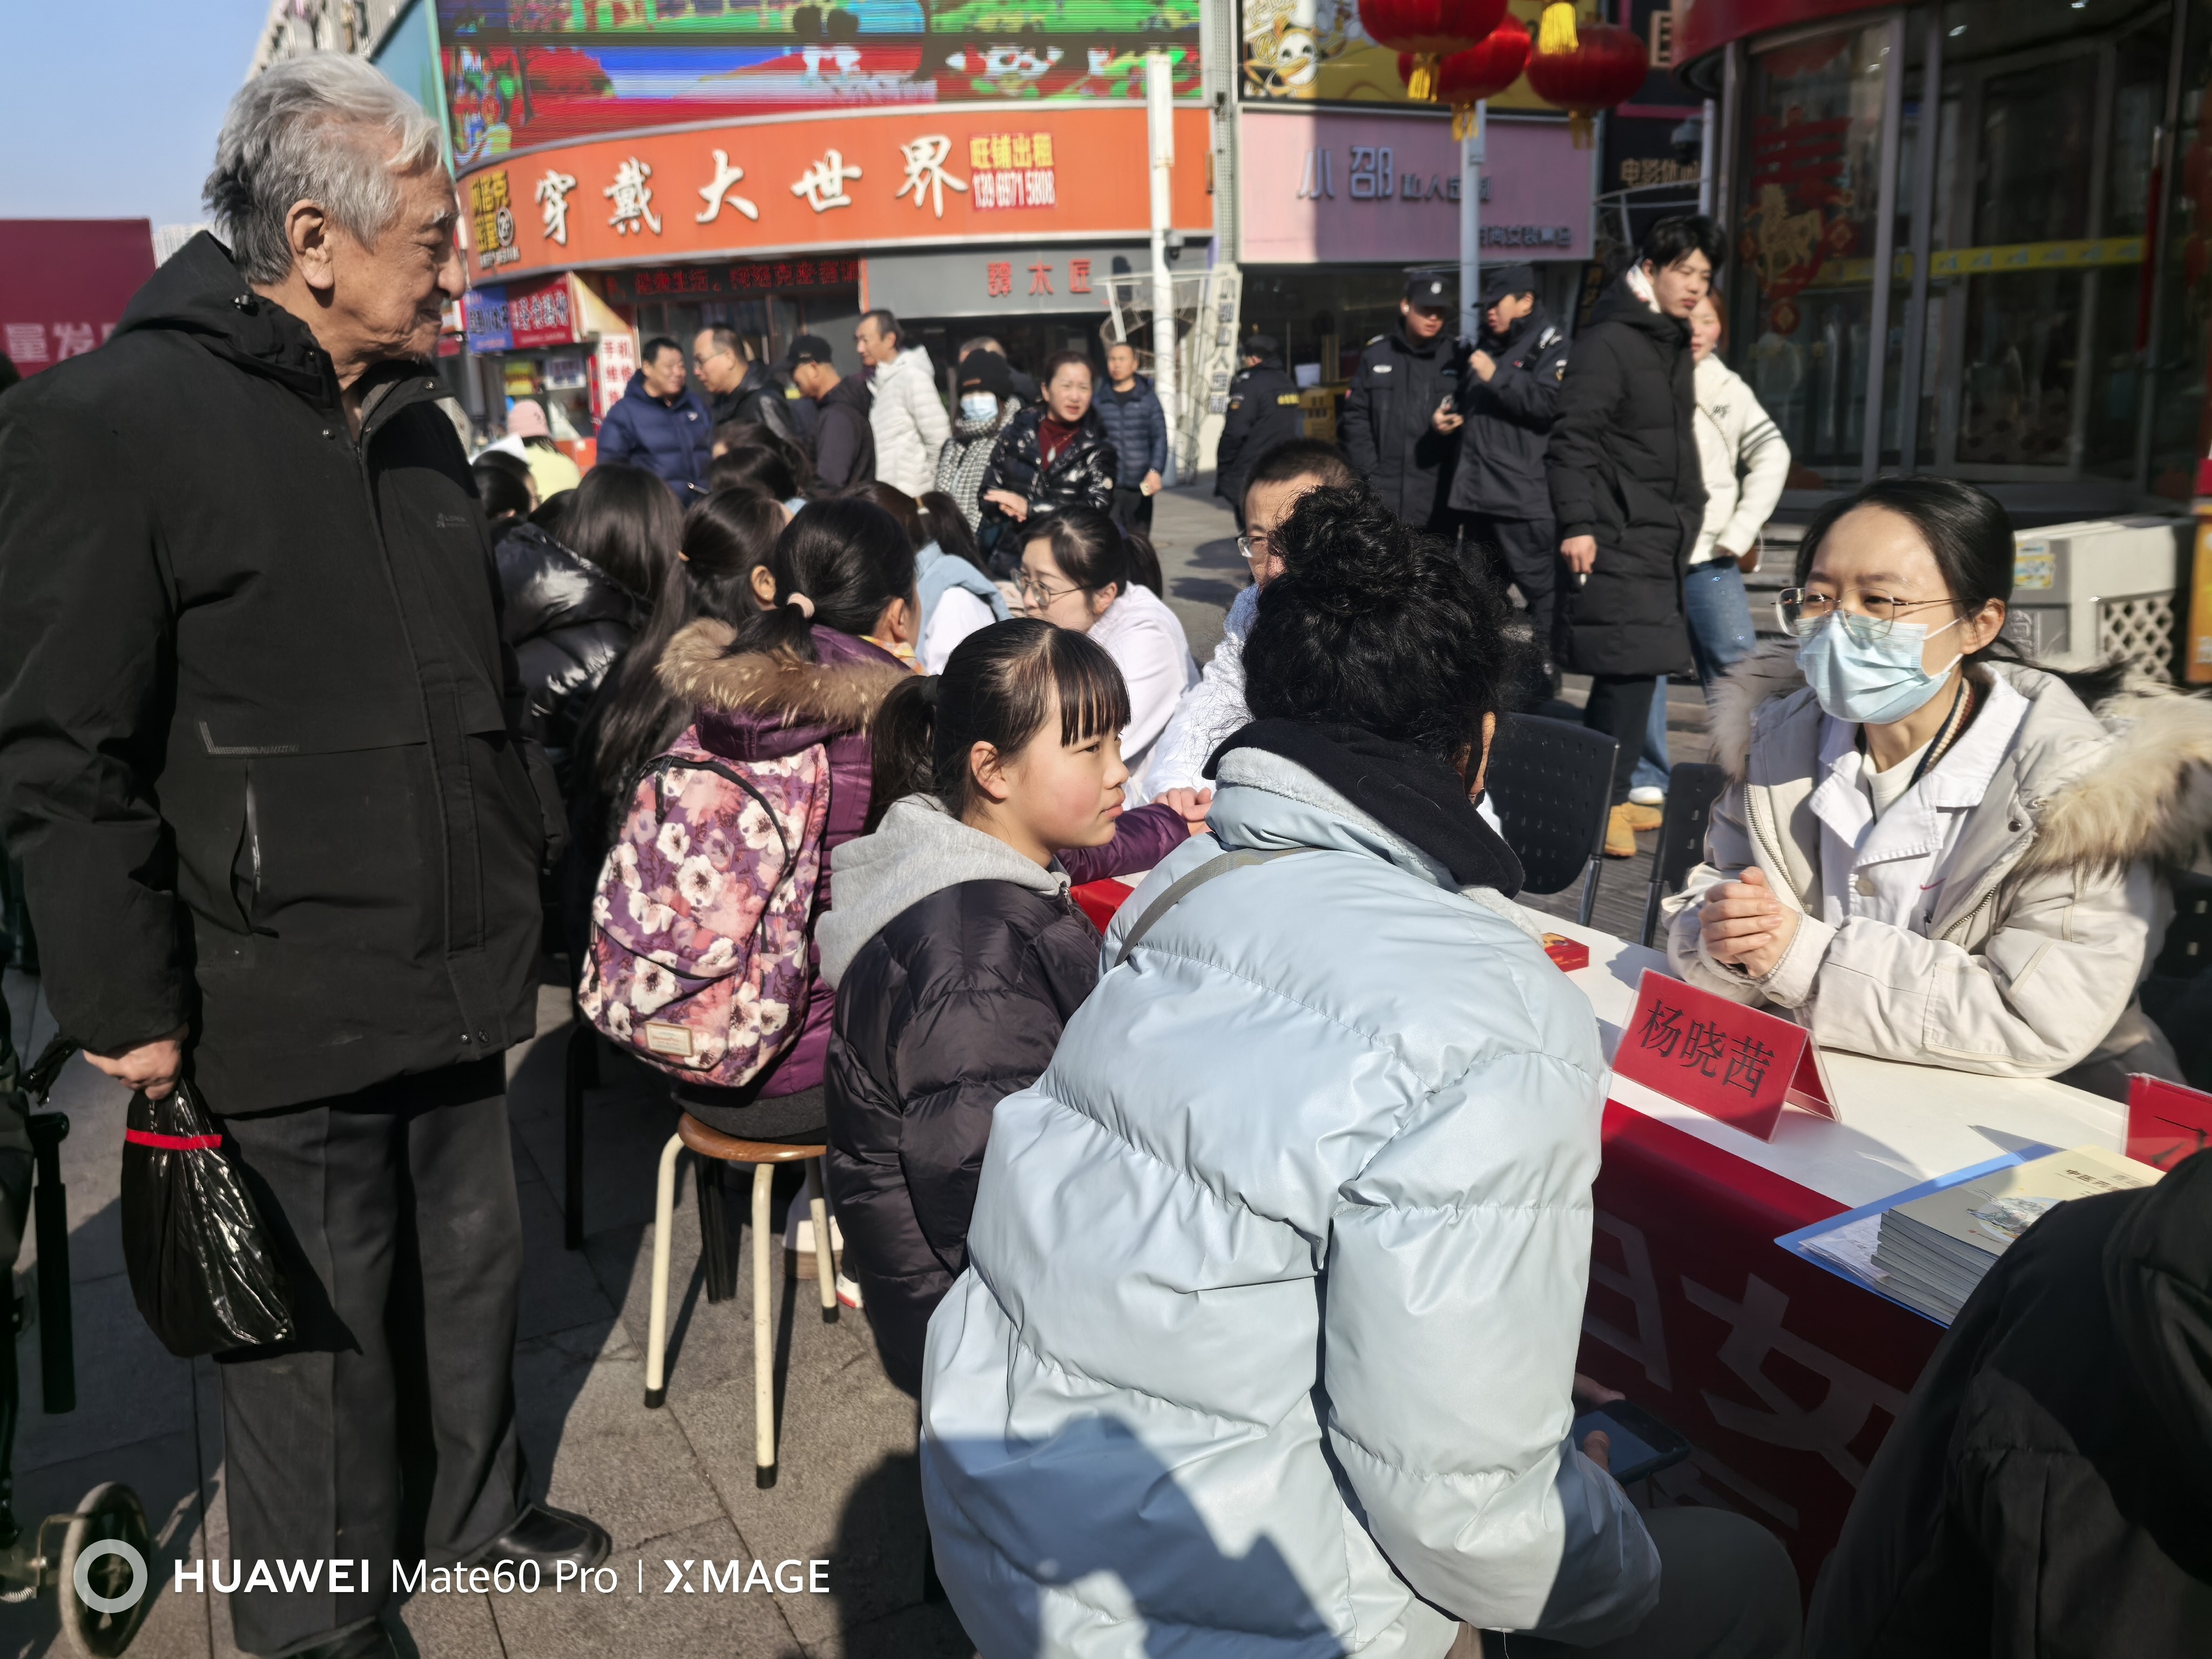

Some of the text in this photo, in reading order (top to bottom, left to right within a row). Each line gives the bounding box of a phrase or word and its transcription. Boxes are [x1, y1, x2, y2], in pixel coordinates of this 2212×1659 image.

[535, 133, 969, 246] 穿戴大世界
[969, 133, 1054, 170] 旺铺出租
[1297, 146, 1394, 199] 小邵
[1638, 999, 1775, 1098] 杨晓茜
